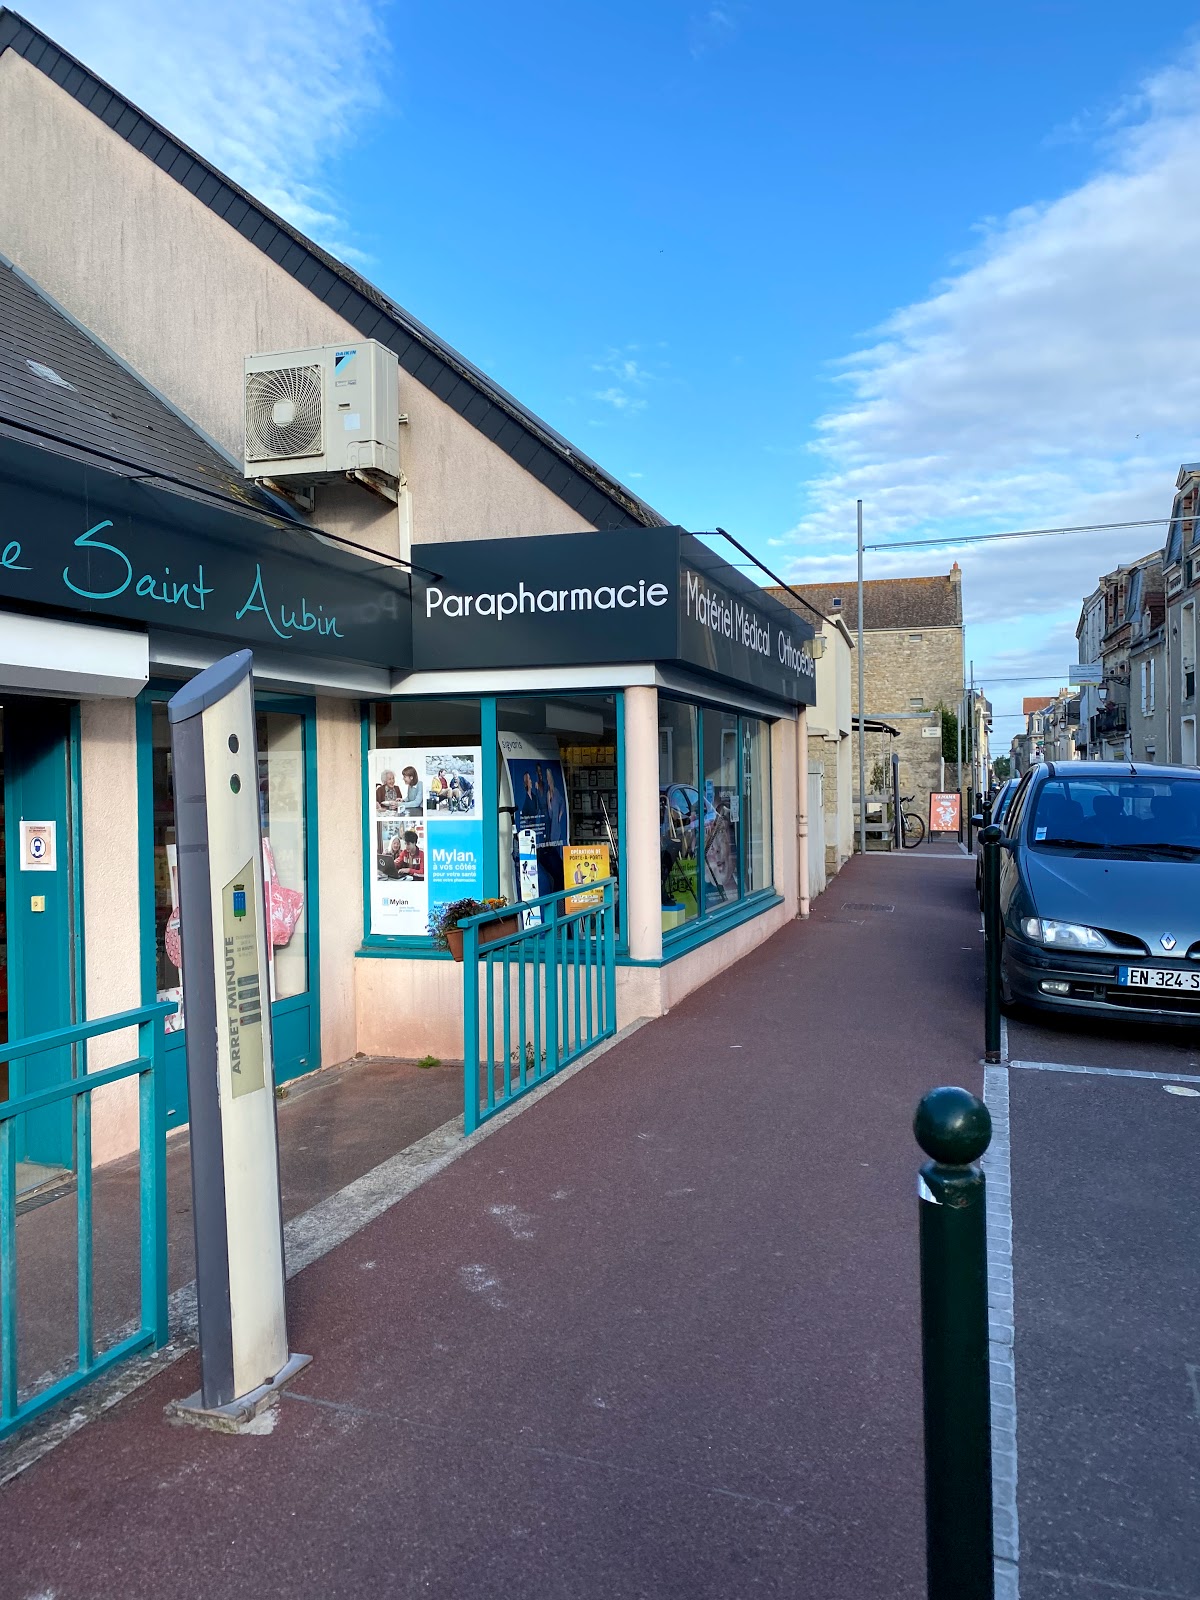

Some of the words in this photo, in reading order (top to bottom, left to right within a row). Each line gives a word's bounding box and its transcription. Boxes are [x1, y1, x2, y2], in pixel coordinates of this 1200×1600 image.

[63, 520, 215, 611] Saint
[236, 563, 344, 639] Aubin
[426, 580, 669, 621] Parapharmacie
[687, 571, 733, 640] Matériel
[735, 603, 771, 657] Médical
[778, 630, 815, 678] Orthopédie
[432, 849, 477, 864] Mylan,
[225, 936, 238, 1010] MINUTE
[230, 1017, 241, 1074] ARRET
